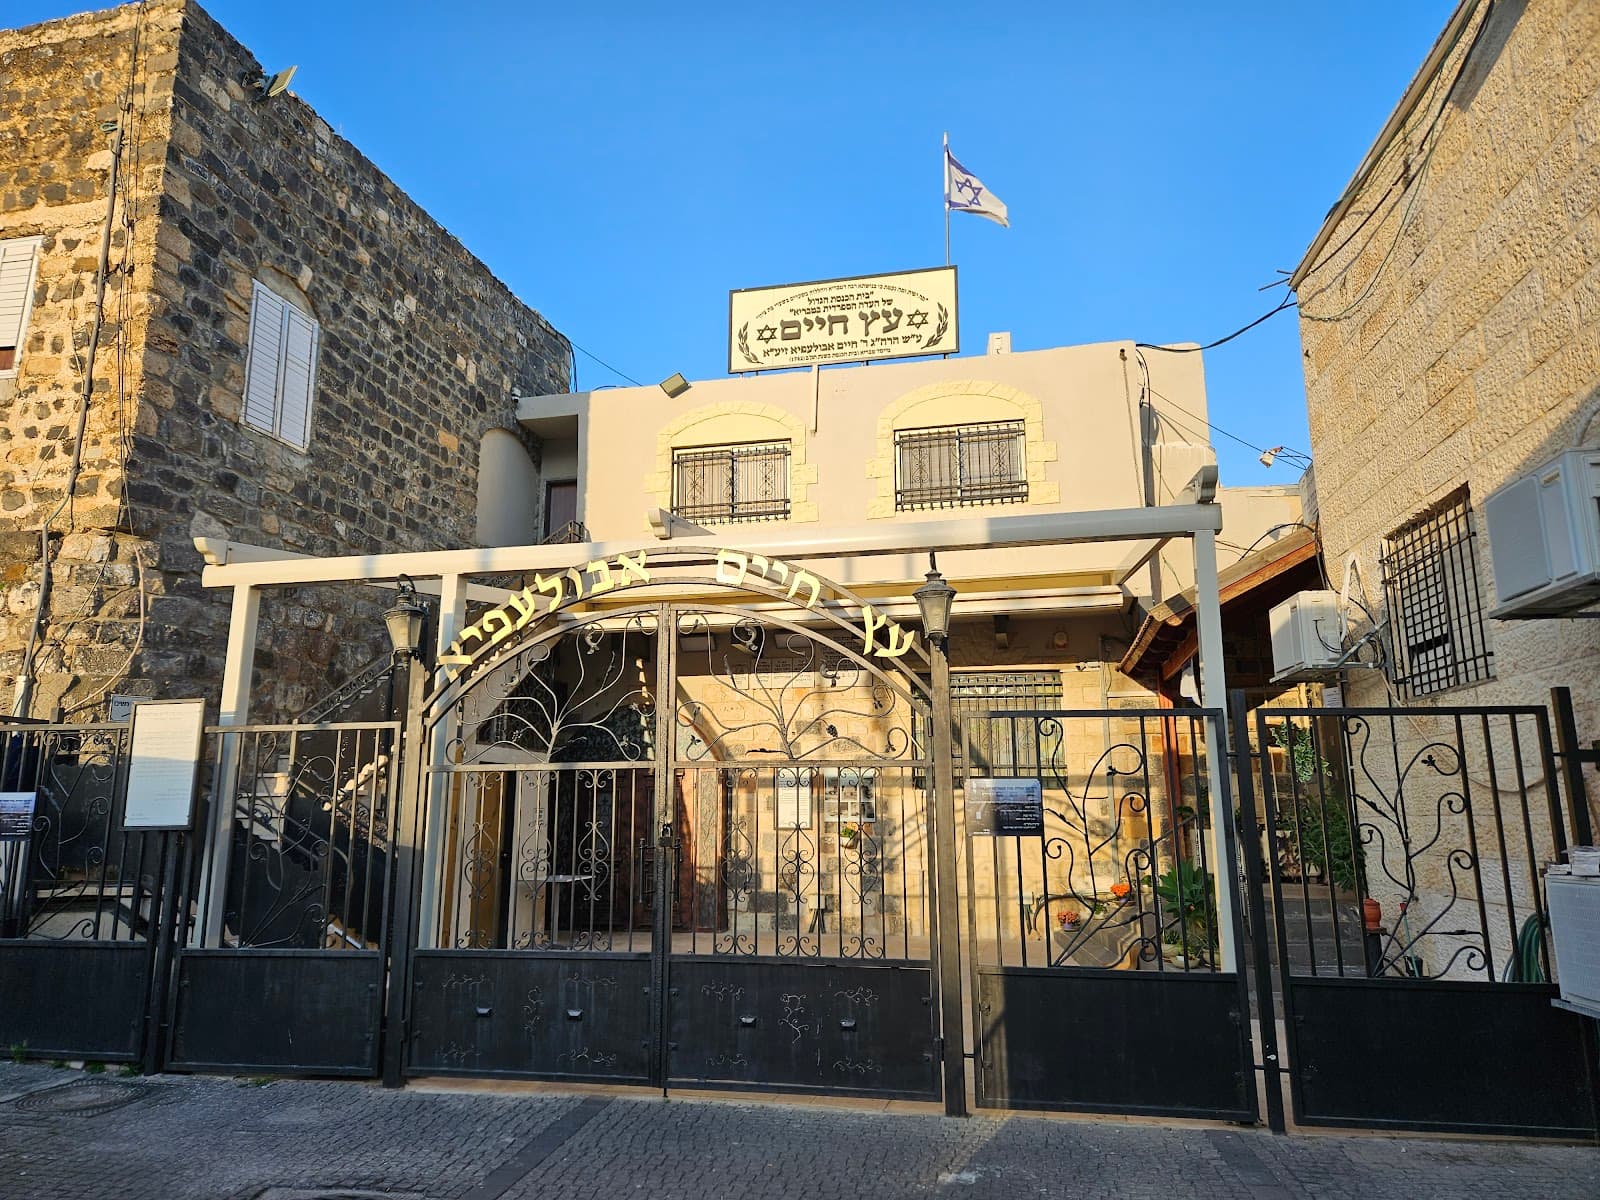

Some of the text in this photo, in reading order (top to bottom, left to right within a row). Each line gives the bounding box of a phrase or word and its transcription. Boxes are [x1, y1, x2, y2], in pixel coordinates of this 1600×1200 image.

[808, 297, 829, 305] הגדול
[830, 294, 855, 303] הכנסת
[881, 298, 893, 306] של
[823, 303, 857, 312] הספרדית
[859, 300, 880, 309] העדה
[779, 307, 904, 341] עץ חיים
[837, 340, 858, 350] חיים
[437, 547, 916, 684] עץ חיים אבולעפיא
